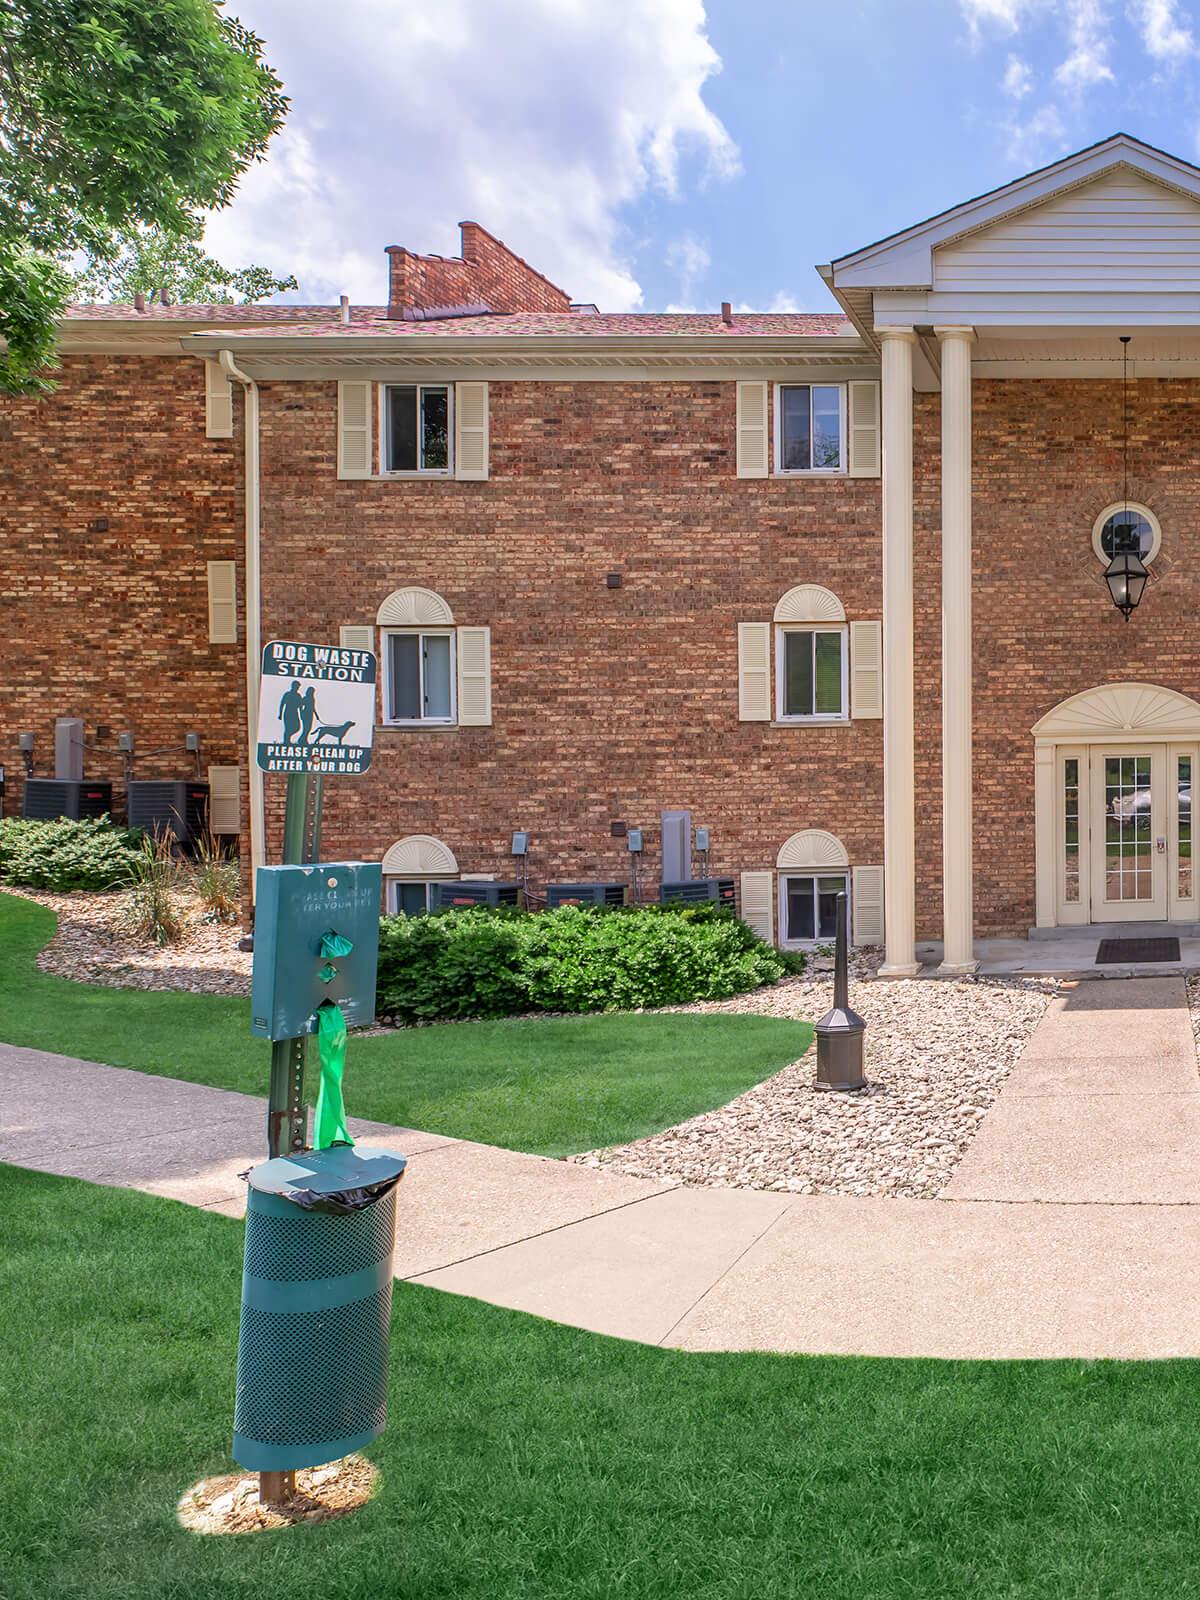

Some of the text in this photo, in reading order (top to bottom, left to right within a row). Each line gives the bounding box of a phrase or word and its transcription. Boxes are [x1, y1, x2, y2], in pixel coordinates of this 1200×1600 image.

[272, 644, 369, 667] DOG WASTE
[278, 662, 363, 682] STATION
[267, 745, 363, 759] PLEASE CLEAN UP
[268, 759, 361, 772] AFTER YOUR DOG
